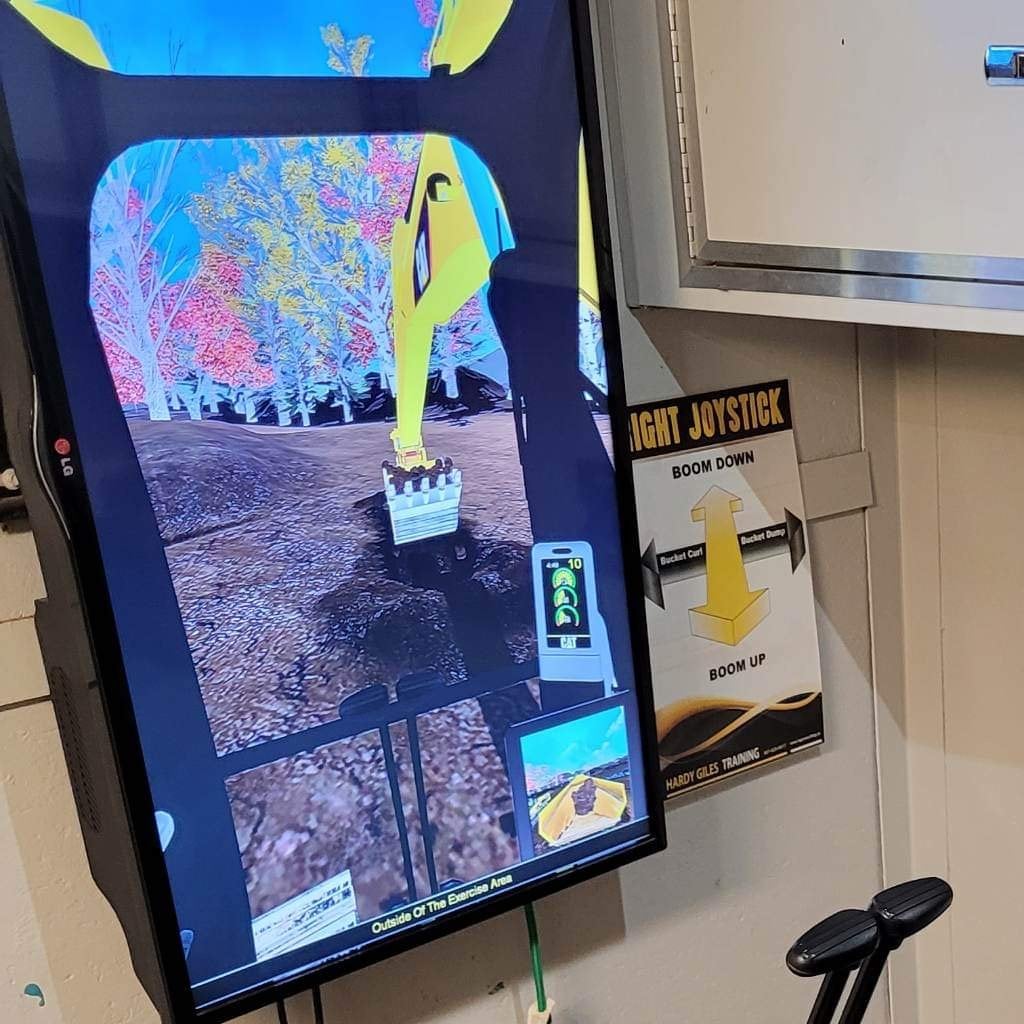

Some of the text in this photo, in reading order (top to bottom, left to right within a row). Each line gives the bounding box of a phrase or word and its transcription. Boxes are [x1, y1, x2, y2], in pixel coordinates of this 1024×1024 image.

[628, 387, 785, 453] IGHT JOYSTICK
[60, 457, 74, 477] LG
[672, 450, 755, 479] BOOM DOWN
[741, 528, 786, 545] Bucket Dump
[568, 558, 582, 569] 10
[660, 547, 704, 565] Bucket Curl
[560, 637, 577, 648] CAT
[709, 653, 767, 681] BOOM UP
[666, 771, 695, 790] HARDY
[696, 761, 720, 780] GILES
[721, 747, 760, 771] TRAINING
[372, 874, 512, 933] Outside Of The Exercise Area
